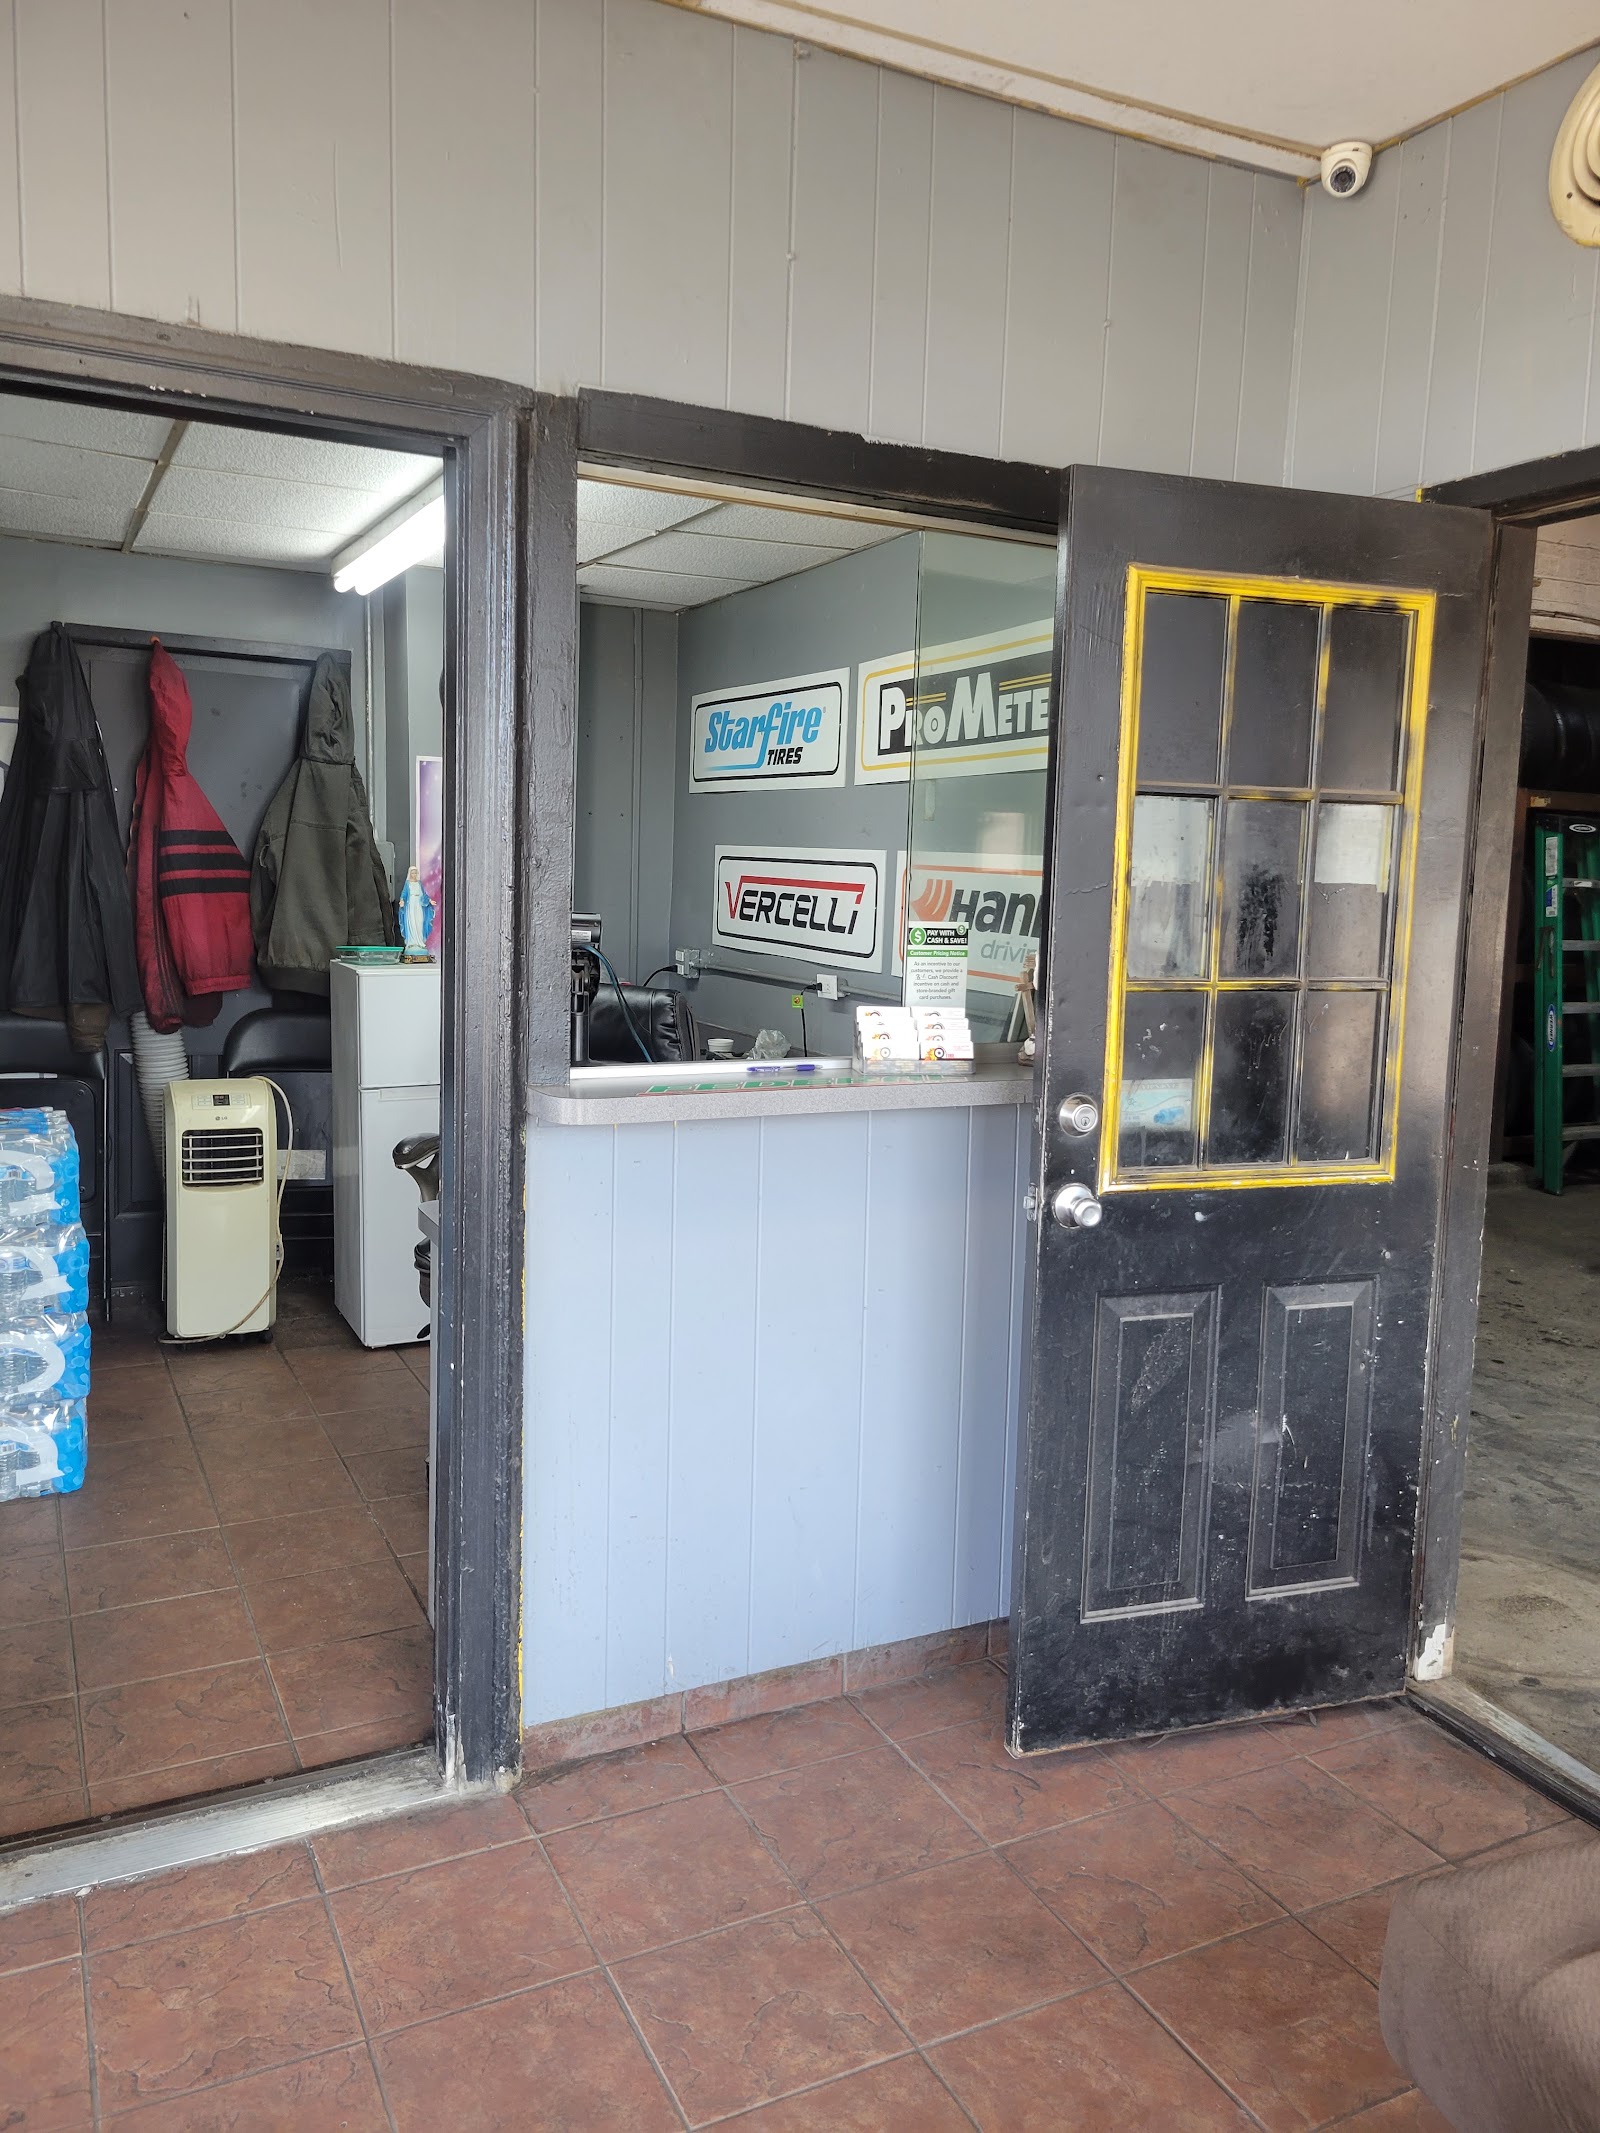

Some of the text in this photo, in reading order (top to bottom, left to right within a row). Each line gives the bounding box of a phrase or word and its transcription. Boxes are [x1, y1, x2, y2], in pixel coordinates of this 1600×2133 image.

[704, 702, 824, 766] Starfire
[767, 746, 804, 766] TIRES
[949, 888, 1042, 938] Han
